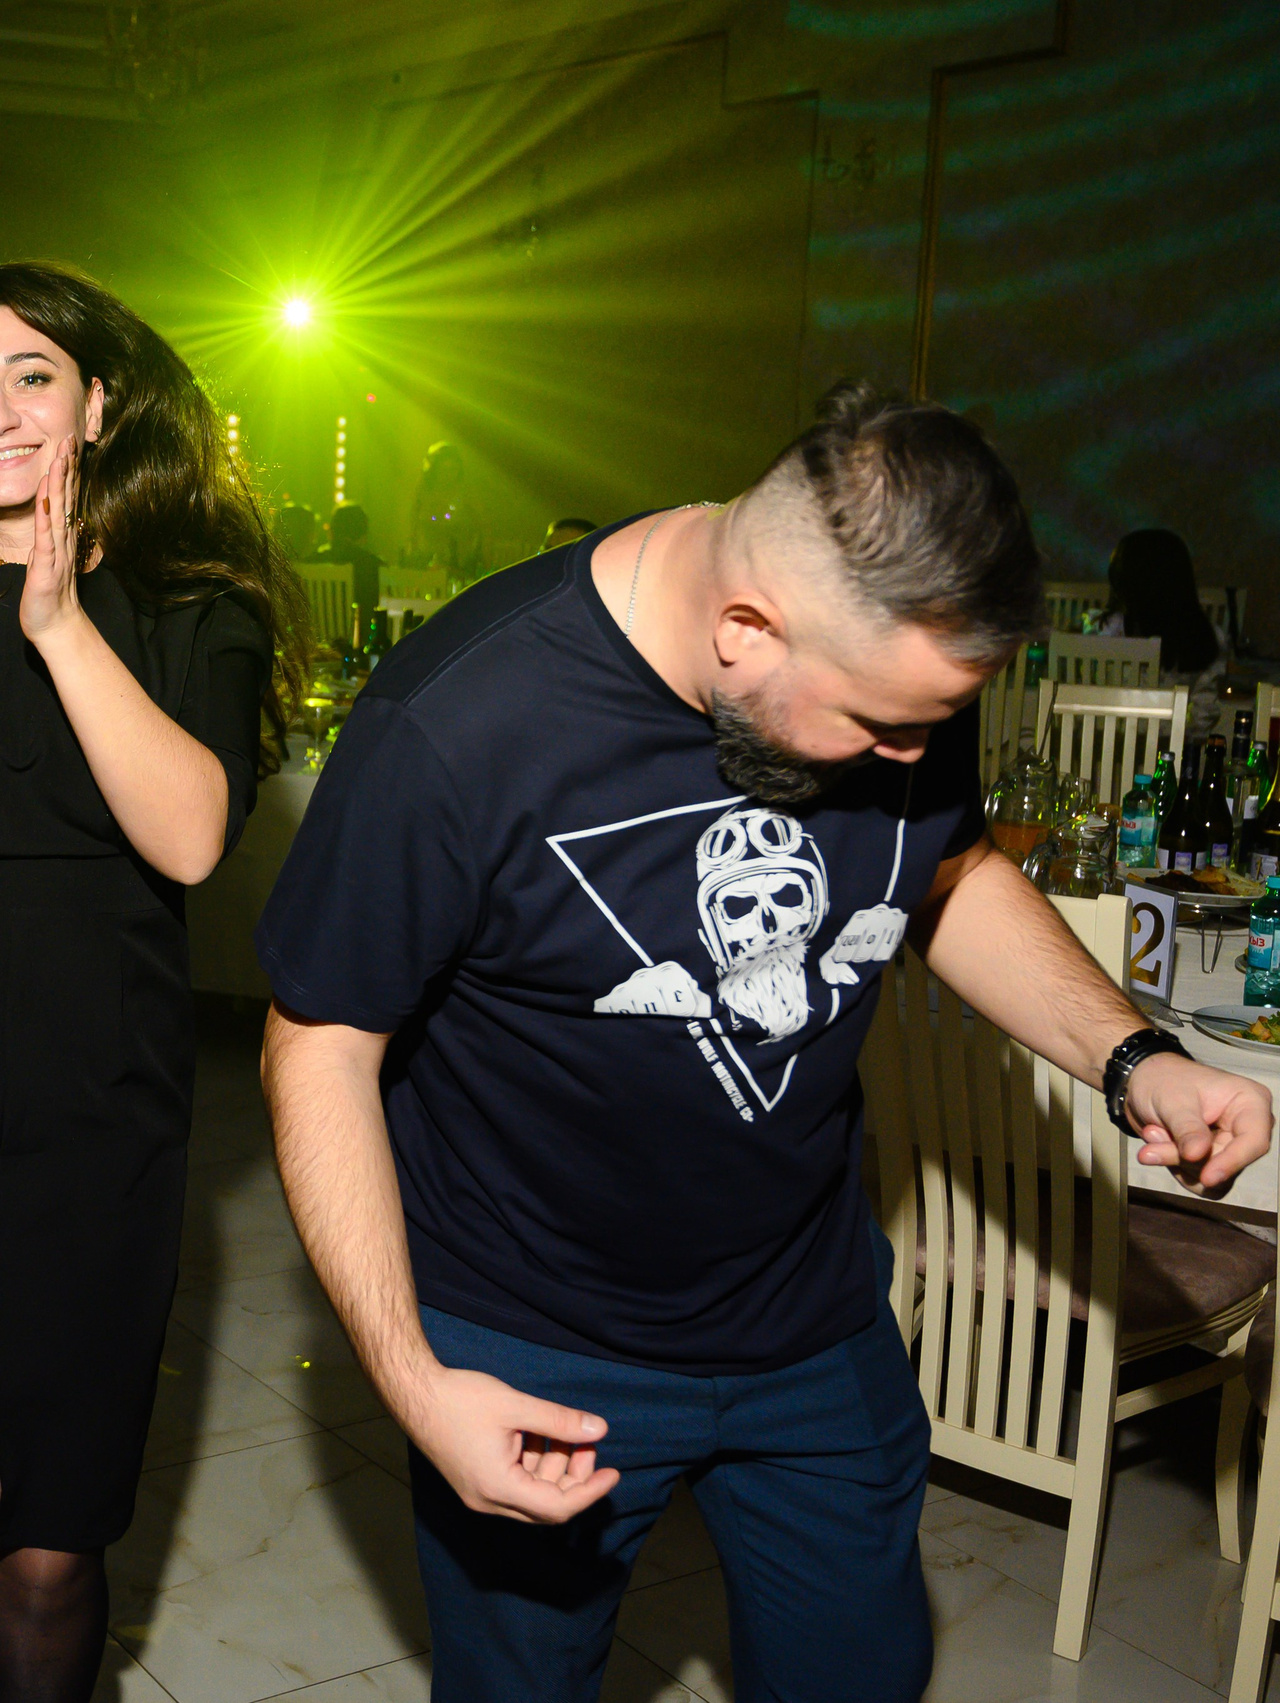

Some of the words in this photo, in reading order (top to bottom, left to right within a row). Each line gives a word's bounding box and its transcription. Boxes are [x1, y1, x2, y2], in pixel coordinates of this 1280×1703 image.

[1130, 901, 1166, 988] 2
[696, 1036, 719, 1063] WOLF
[710, 1060, 748, 1110] MOTORCYCLE
